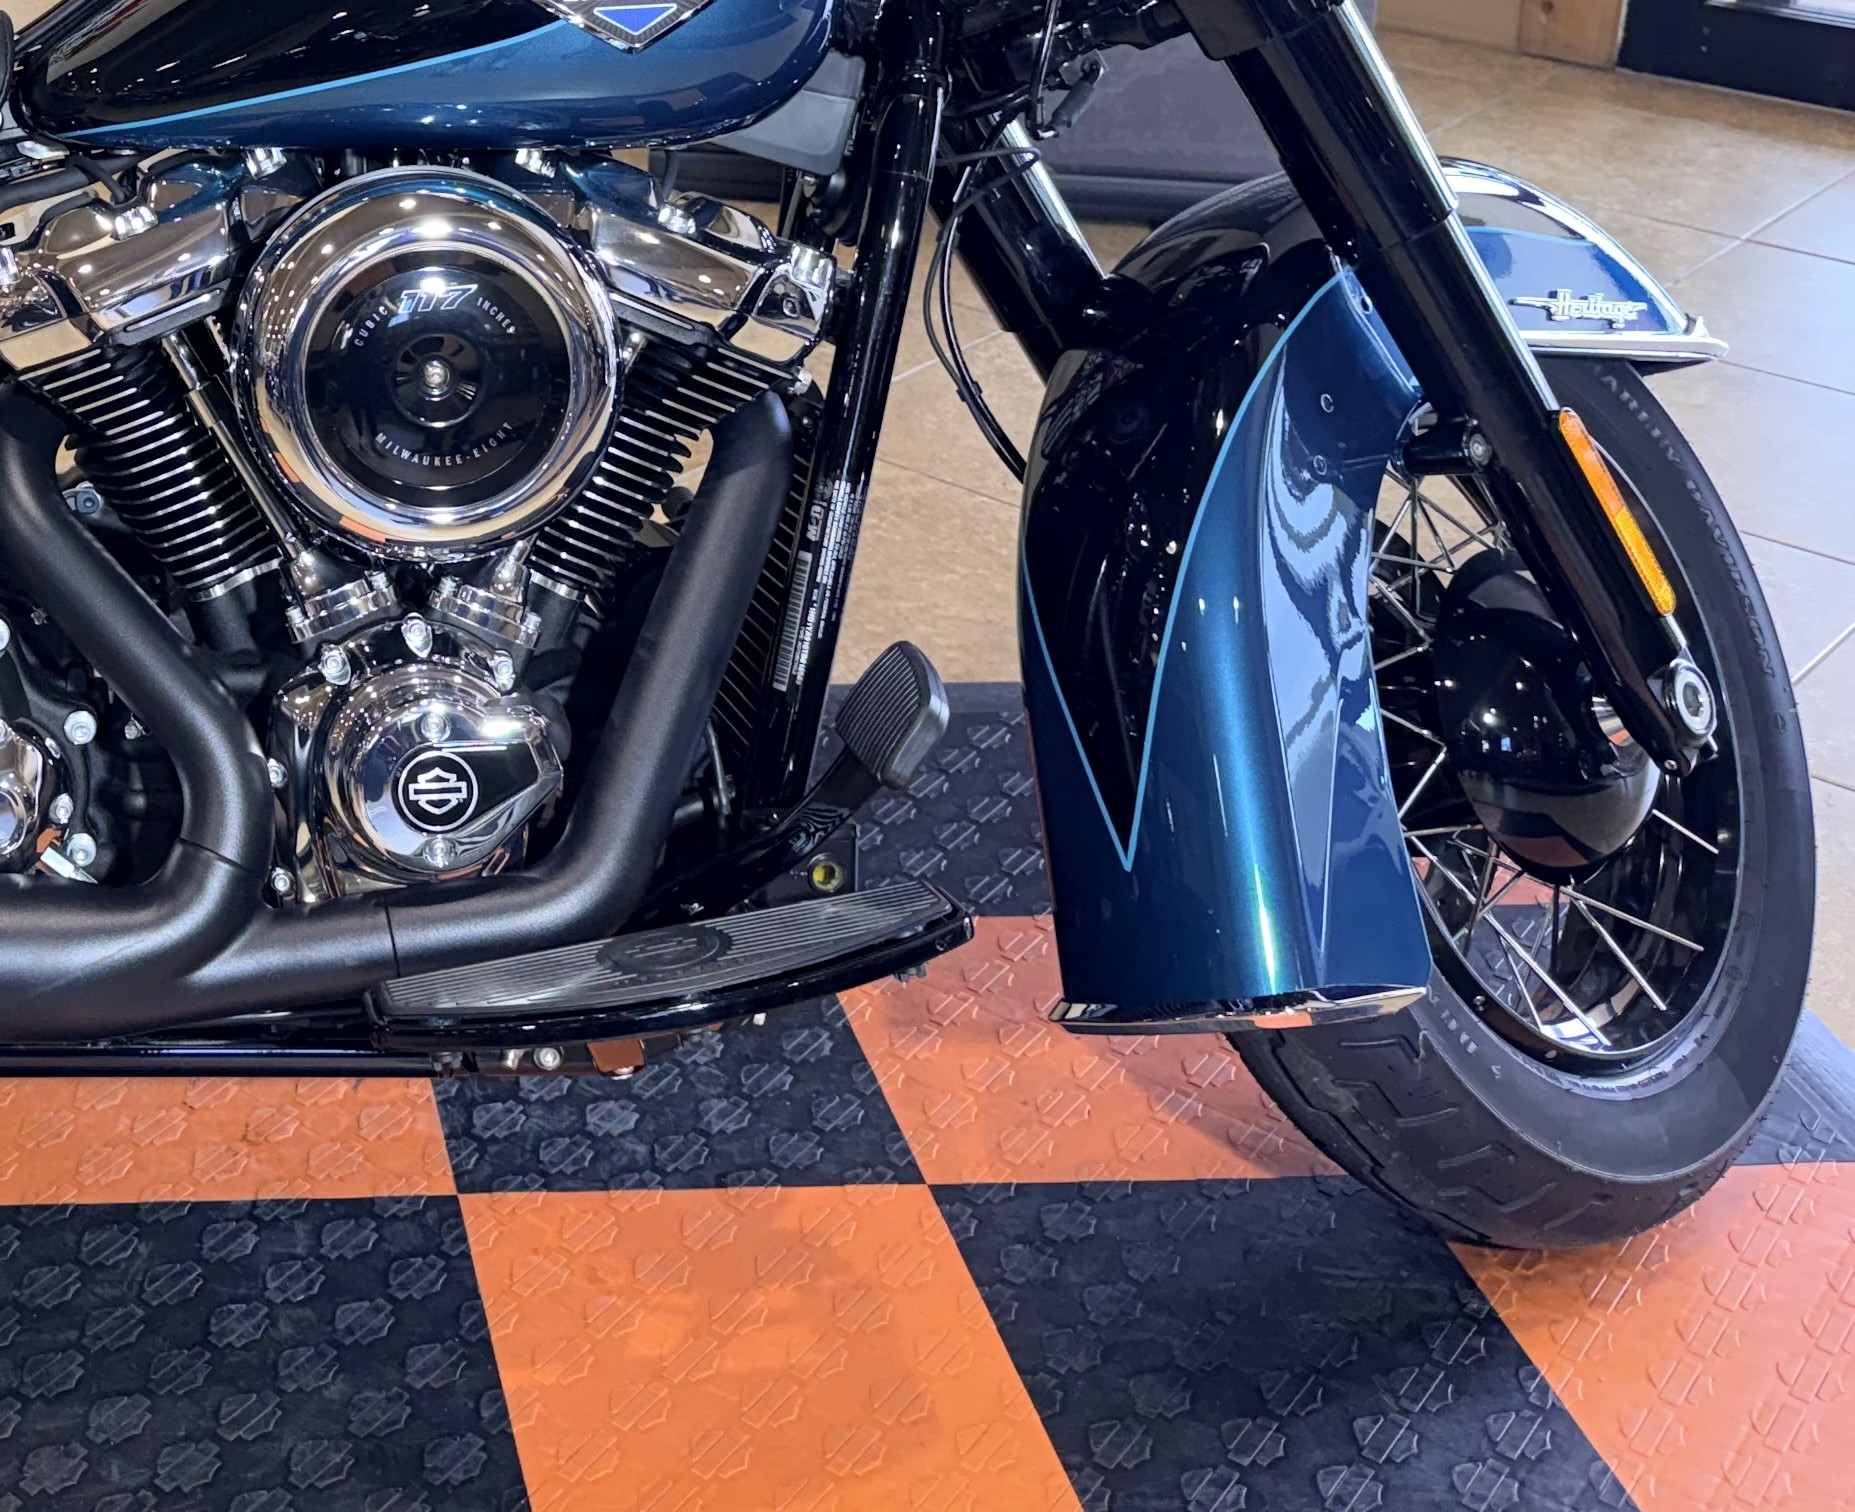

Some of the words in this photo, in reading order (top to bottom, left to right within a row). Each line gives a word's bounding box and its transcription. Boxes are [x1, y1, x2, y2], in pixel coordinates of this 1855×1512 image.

[354, 305, 388, 347] CUBIC
[398, 283, 479, 314] 117
[477, 297, 516, 334] INCHES
[375, 421, 513, 467] MILWAUKEE-EIGHT
